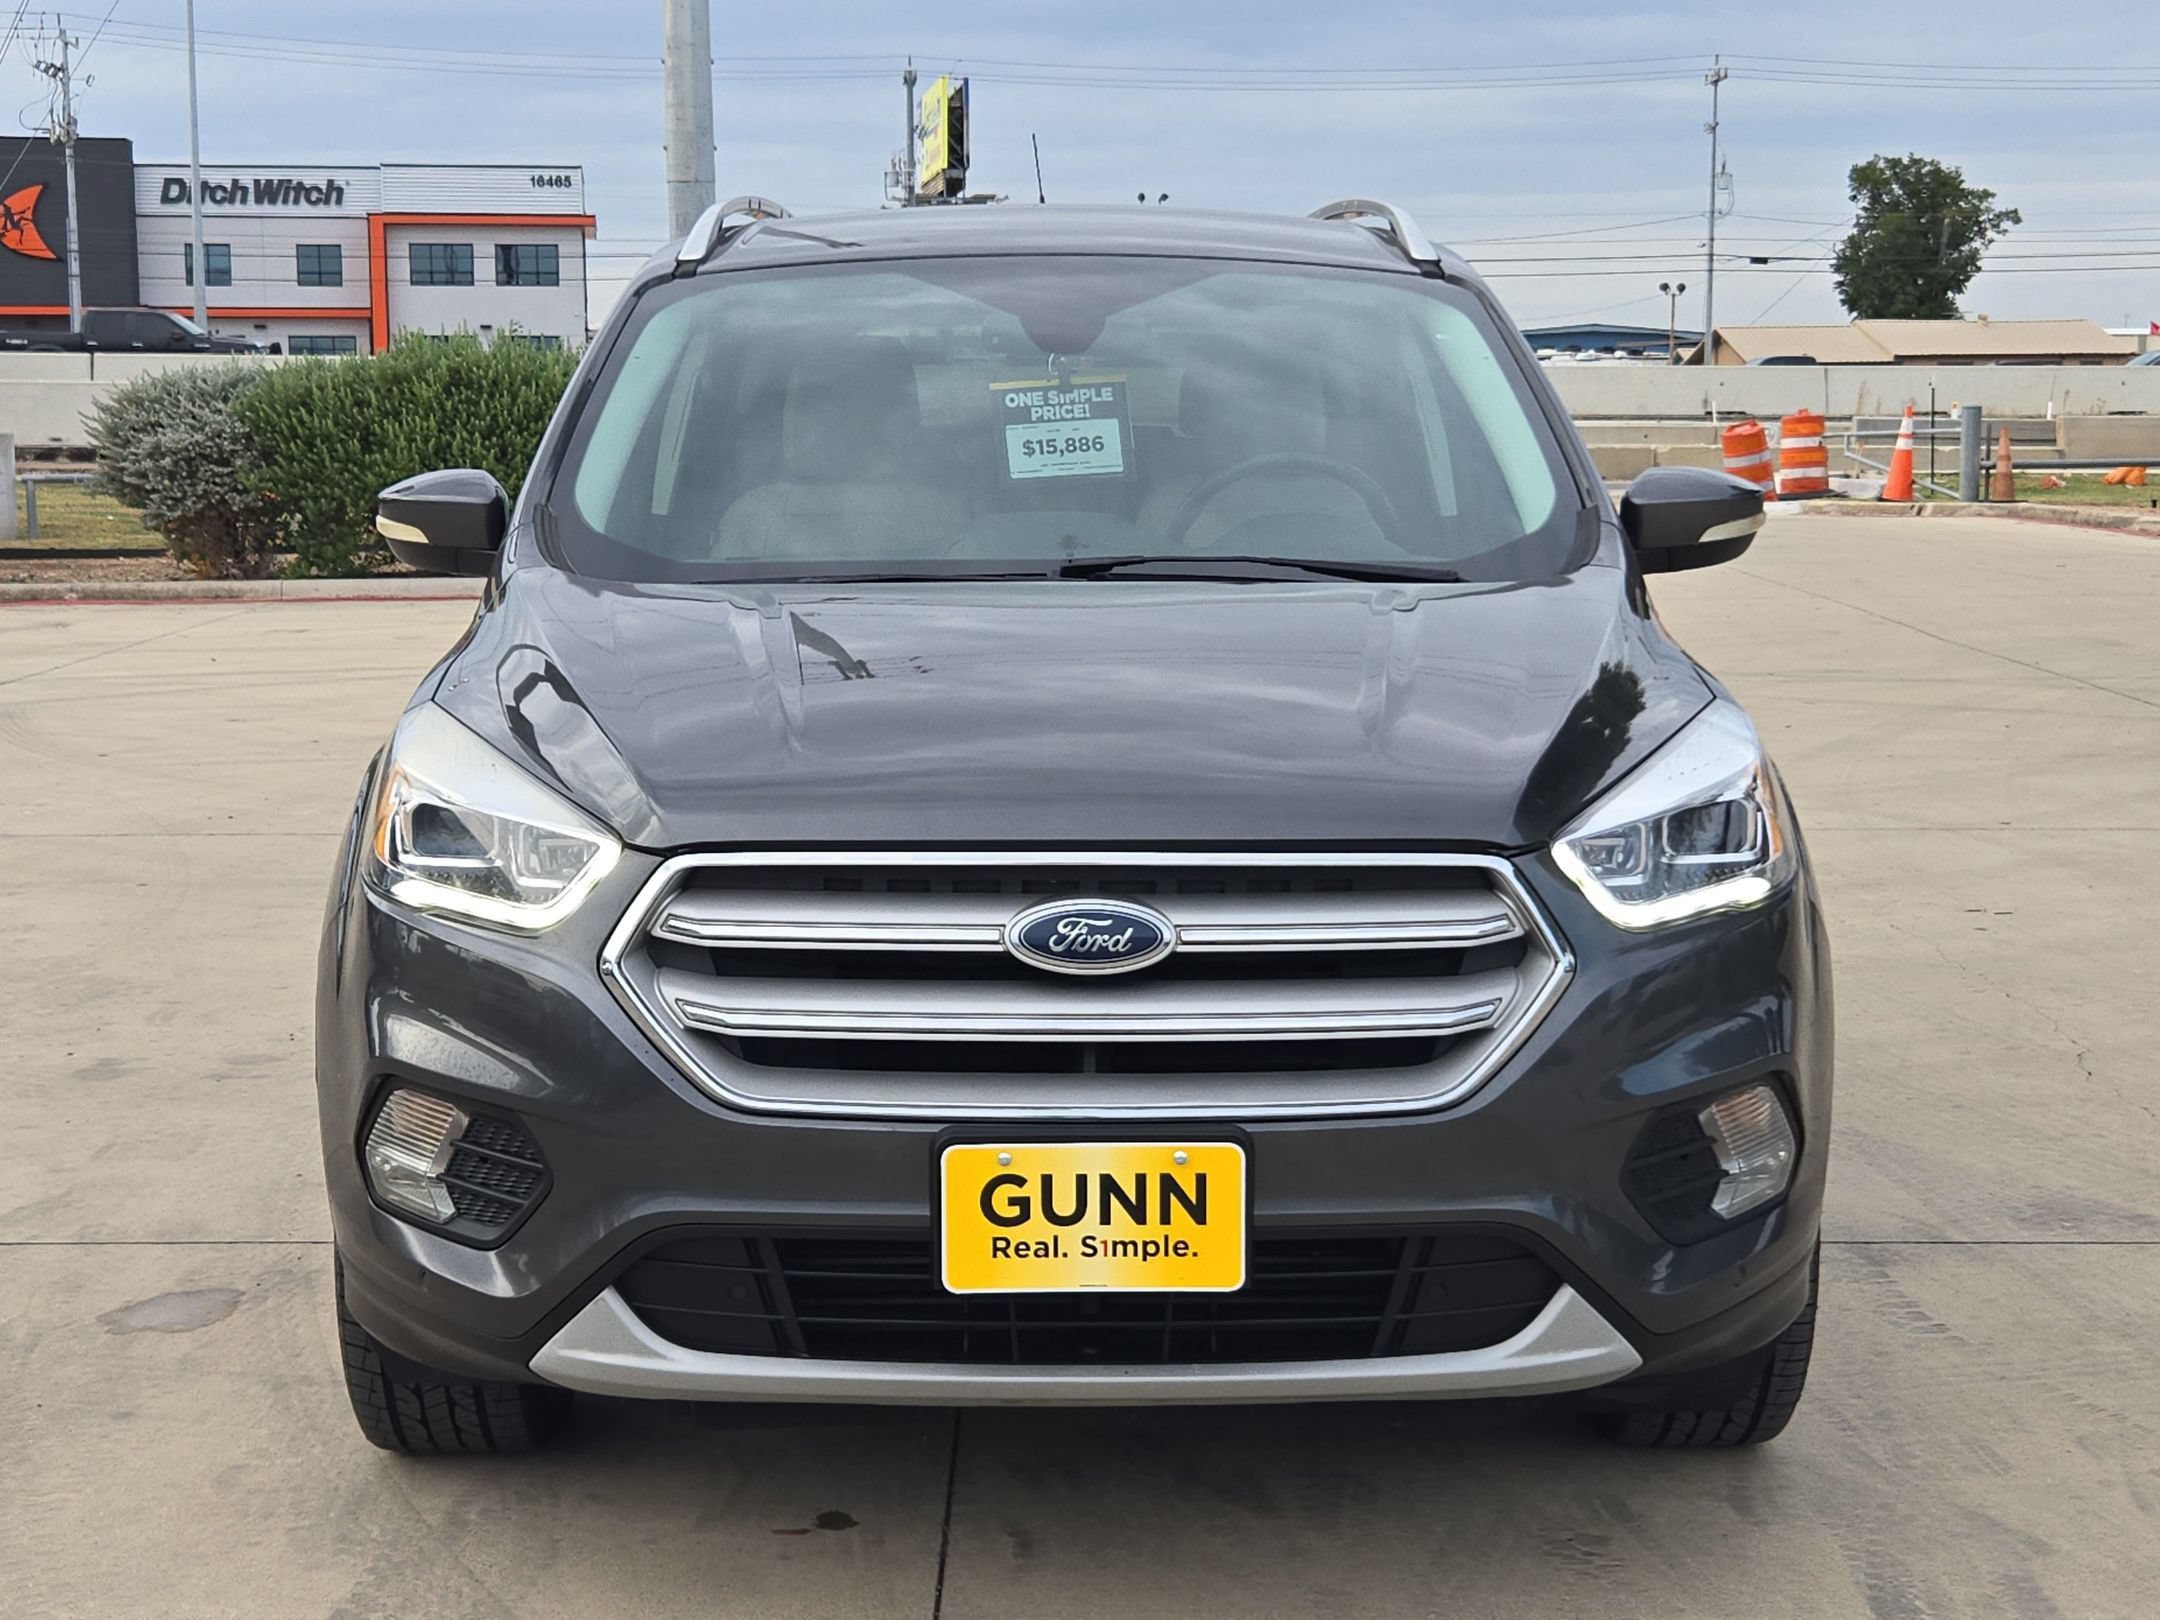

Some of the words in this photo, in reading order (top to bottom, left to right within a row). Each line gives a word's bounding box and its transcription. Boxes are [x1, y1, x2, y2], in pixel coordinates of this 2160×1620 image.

[253, 178, 345, 205] Witch
[530, 174, 572, 188] 16465
[1005, 391, 1044, 407] ONE
[1031, 404, 1090, 421] PRICE!
[1022, 435, 1105, 458] $15,886
[1048, 917, 1134, 952] Ford
[979, 1172, 1207, 1228] GUNN
[991, 1234, 1068, 1259] Real.
